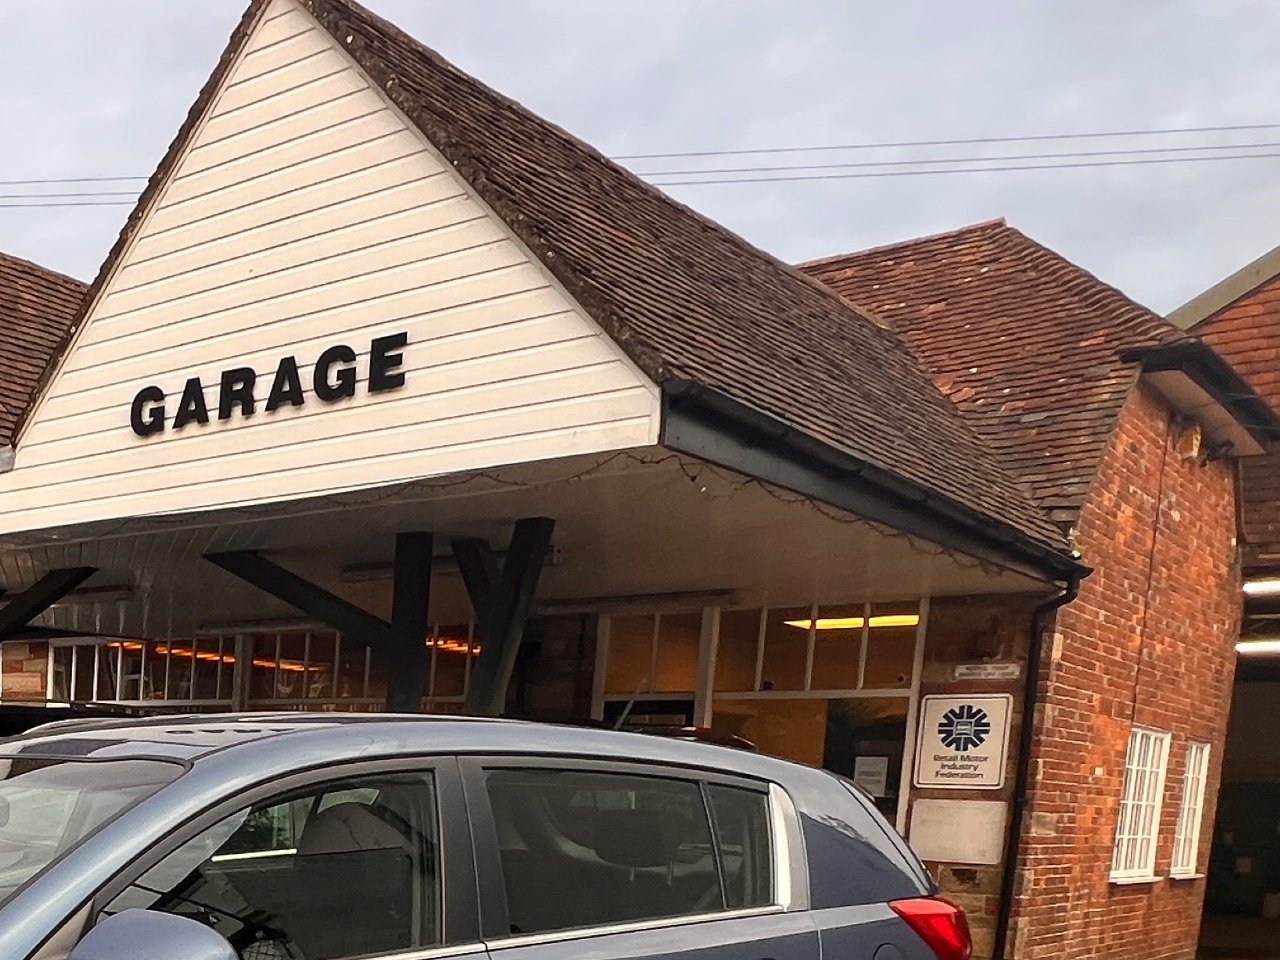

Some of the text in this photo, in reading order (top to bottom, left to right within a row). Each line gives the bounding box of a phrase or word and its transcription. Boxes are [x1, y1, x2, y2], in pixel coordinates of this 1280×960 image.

[130, 331, 408, 436] GARAGE
[933, 754, 989, 762] Retail Motor
[940, 762, 979, 771] Industry
[934, 770, 984, 779] Federation
